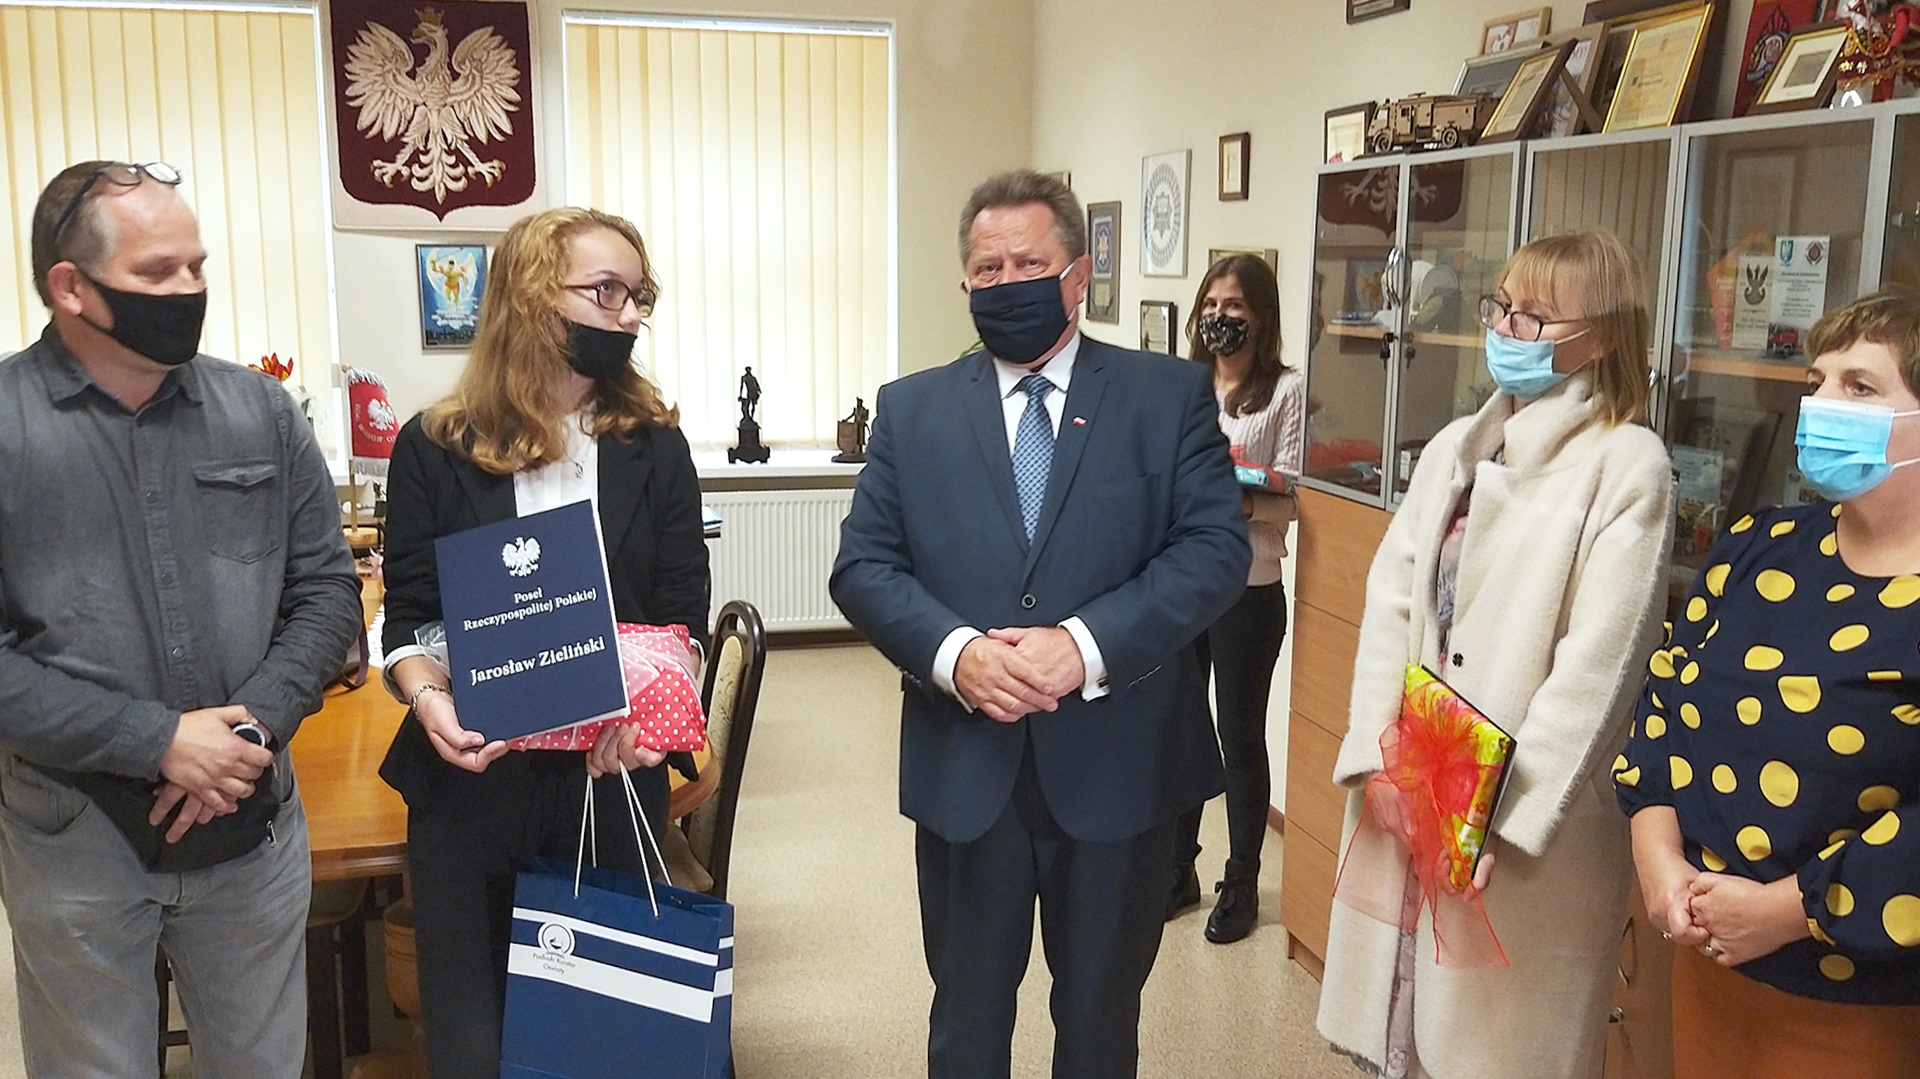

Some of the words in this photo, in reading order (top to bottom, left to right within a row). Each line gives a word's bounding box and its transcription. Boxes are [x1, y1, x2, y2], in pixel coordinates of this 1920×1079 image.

[463, 602, 553, 631] Rzeczypospolitej
[555, 587, 597, 609] Polskiej
[514, 586, 543, 604] Poseł
[470, 657, 536, 686] Jarosław
[539, 636, 606, 667] Zieliński
